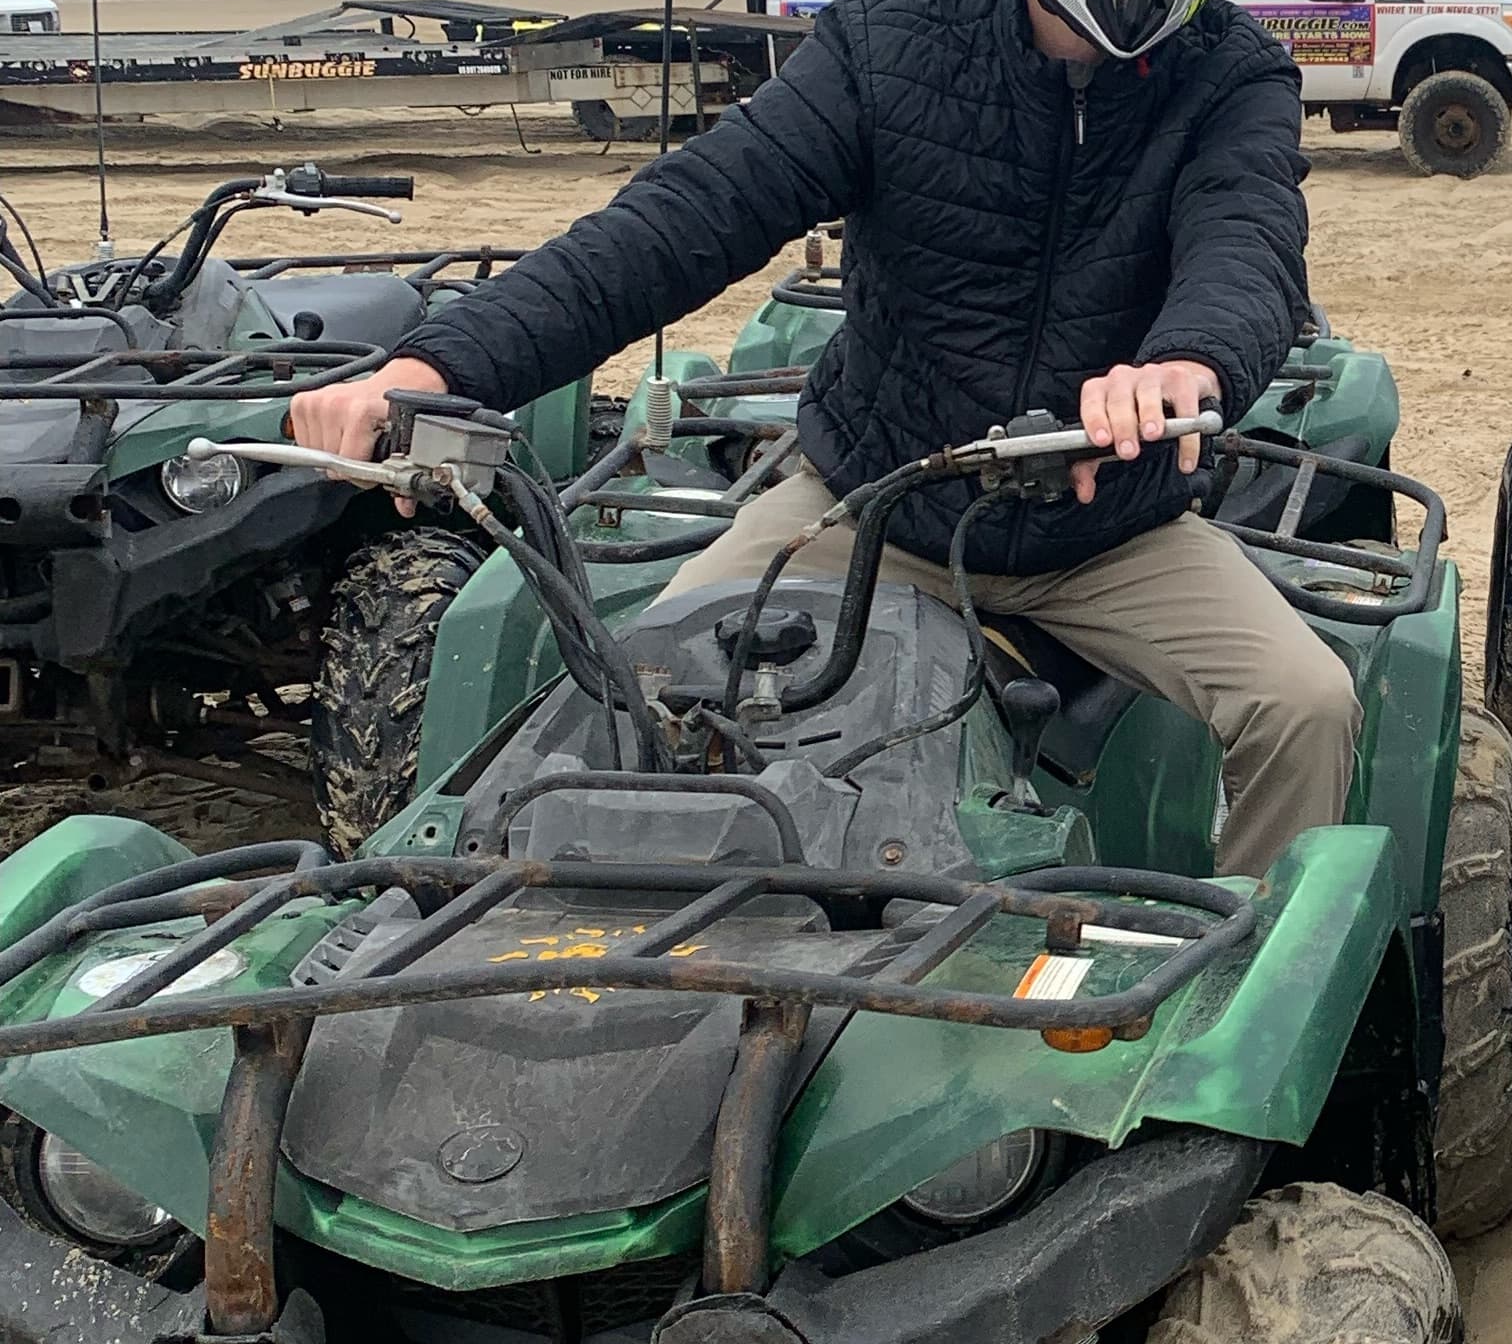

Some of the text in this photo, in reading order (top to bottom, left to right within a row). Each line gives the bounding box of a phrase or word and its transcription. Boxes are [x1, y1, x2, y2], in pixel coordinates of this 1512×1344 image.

[1377, 6, 1405, 15] WHERE
[1409, 6, 1423, 15] THE
[1426, 6, 1443, 15] FUN
[1446, 6, 1473, 15] NEVER
[239, 61, 377, 80] SUNBUGGIE
[550, 67, 612, 80] NOT FOR HIRE
